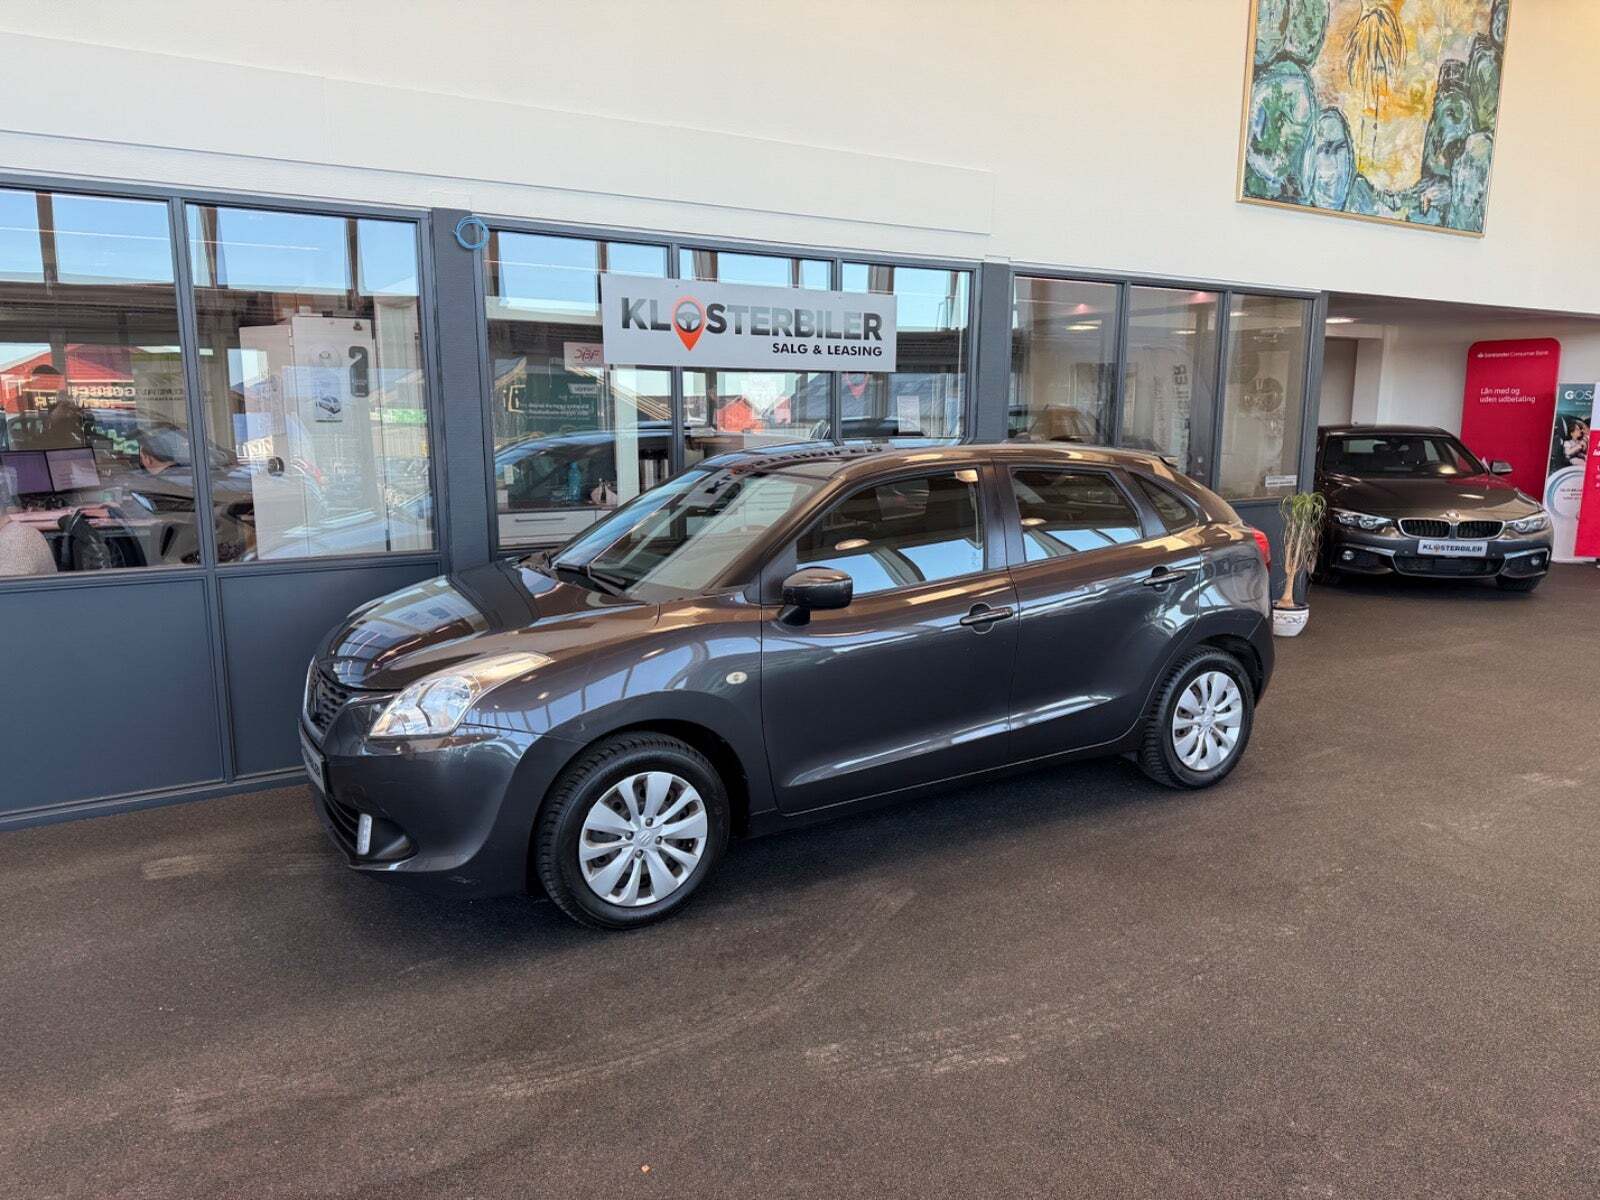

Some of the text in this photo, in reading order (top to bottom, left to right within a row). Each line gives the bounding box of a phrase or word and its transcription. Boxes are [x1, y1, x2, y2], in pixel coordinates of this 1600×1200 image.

[621, 295, 883, 345] KLOSTERBILER
[772, 342, 883, 357] SALG & LEASING
[1480, 387, 1493, 395] Lån
[1498, 395, 1536, 404] udbetaling
